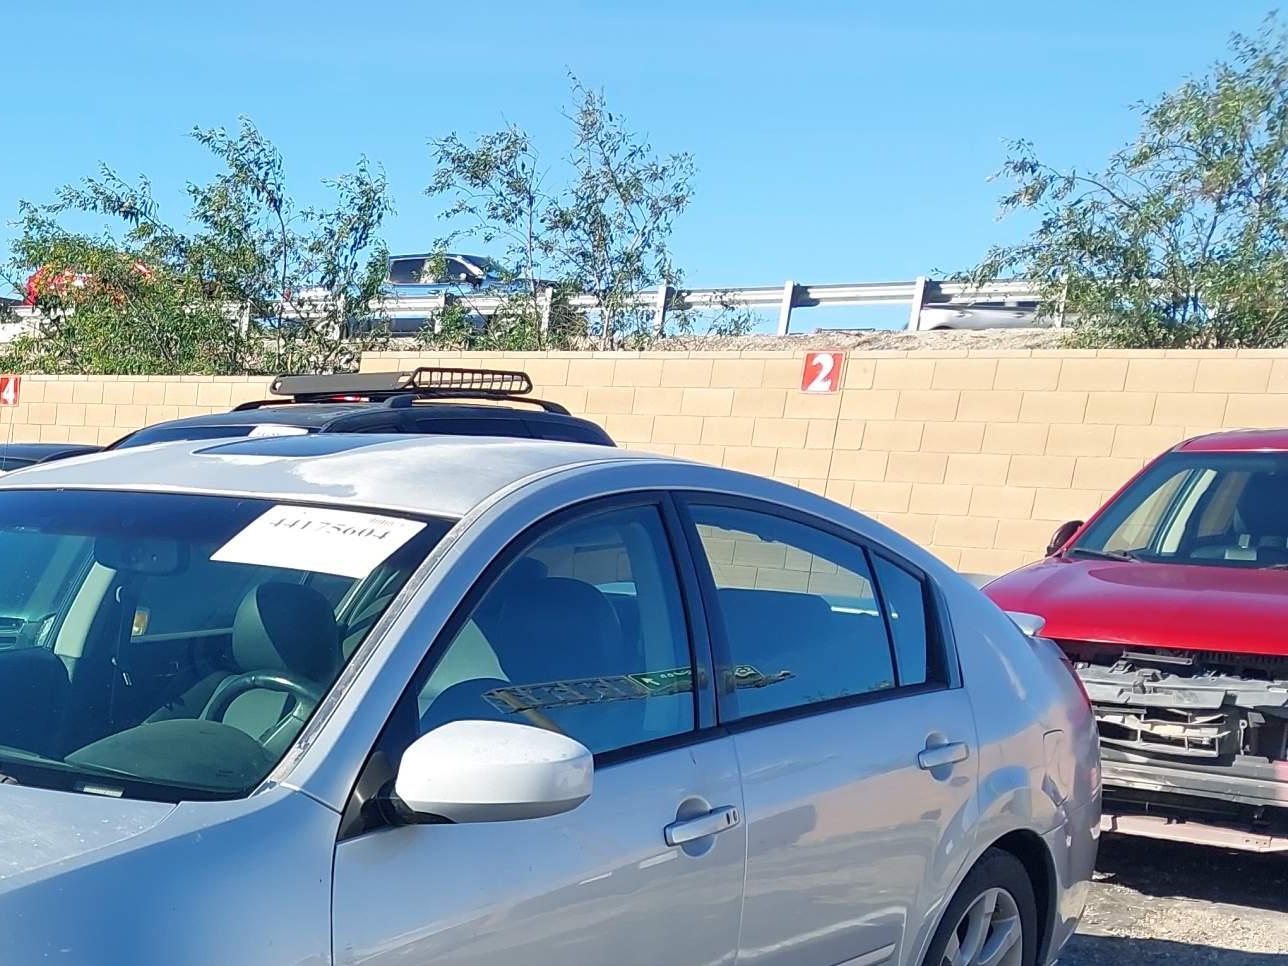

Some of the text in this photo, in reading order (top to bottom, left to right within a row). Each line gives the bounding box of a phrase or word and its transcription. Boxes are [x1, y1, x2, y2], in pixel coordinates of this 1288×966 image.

[807, 353, 834, 392] 2
[2, 376, 16, 405] 4
[268, 517, 392, 540] 44175604
